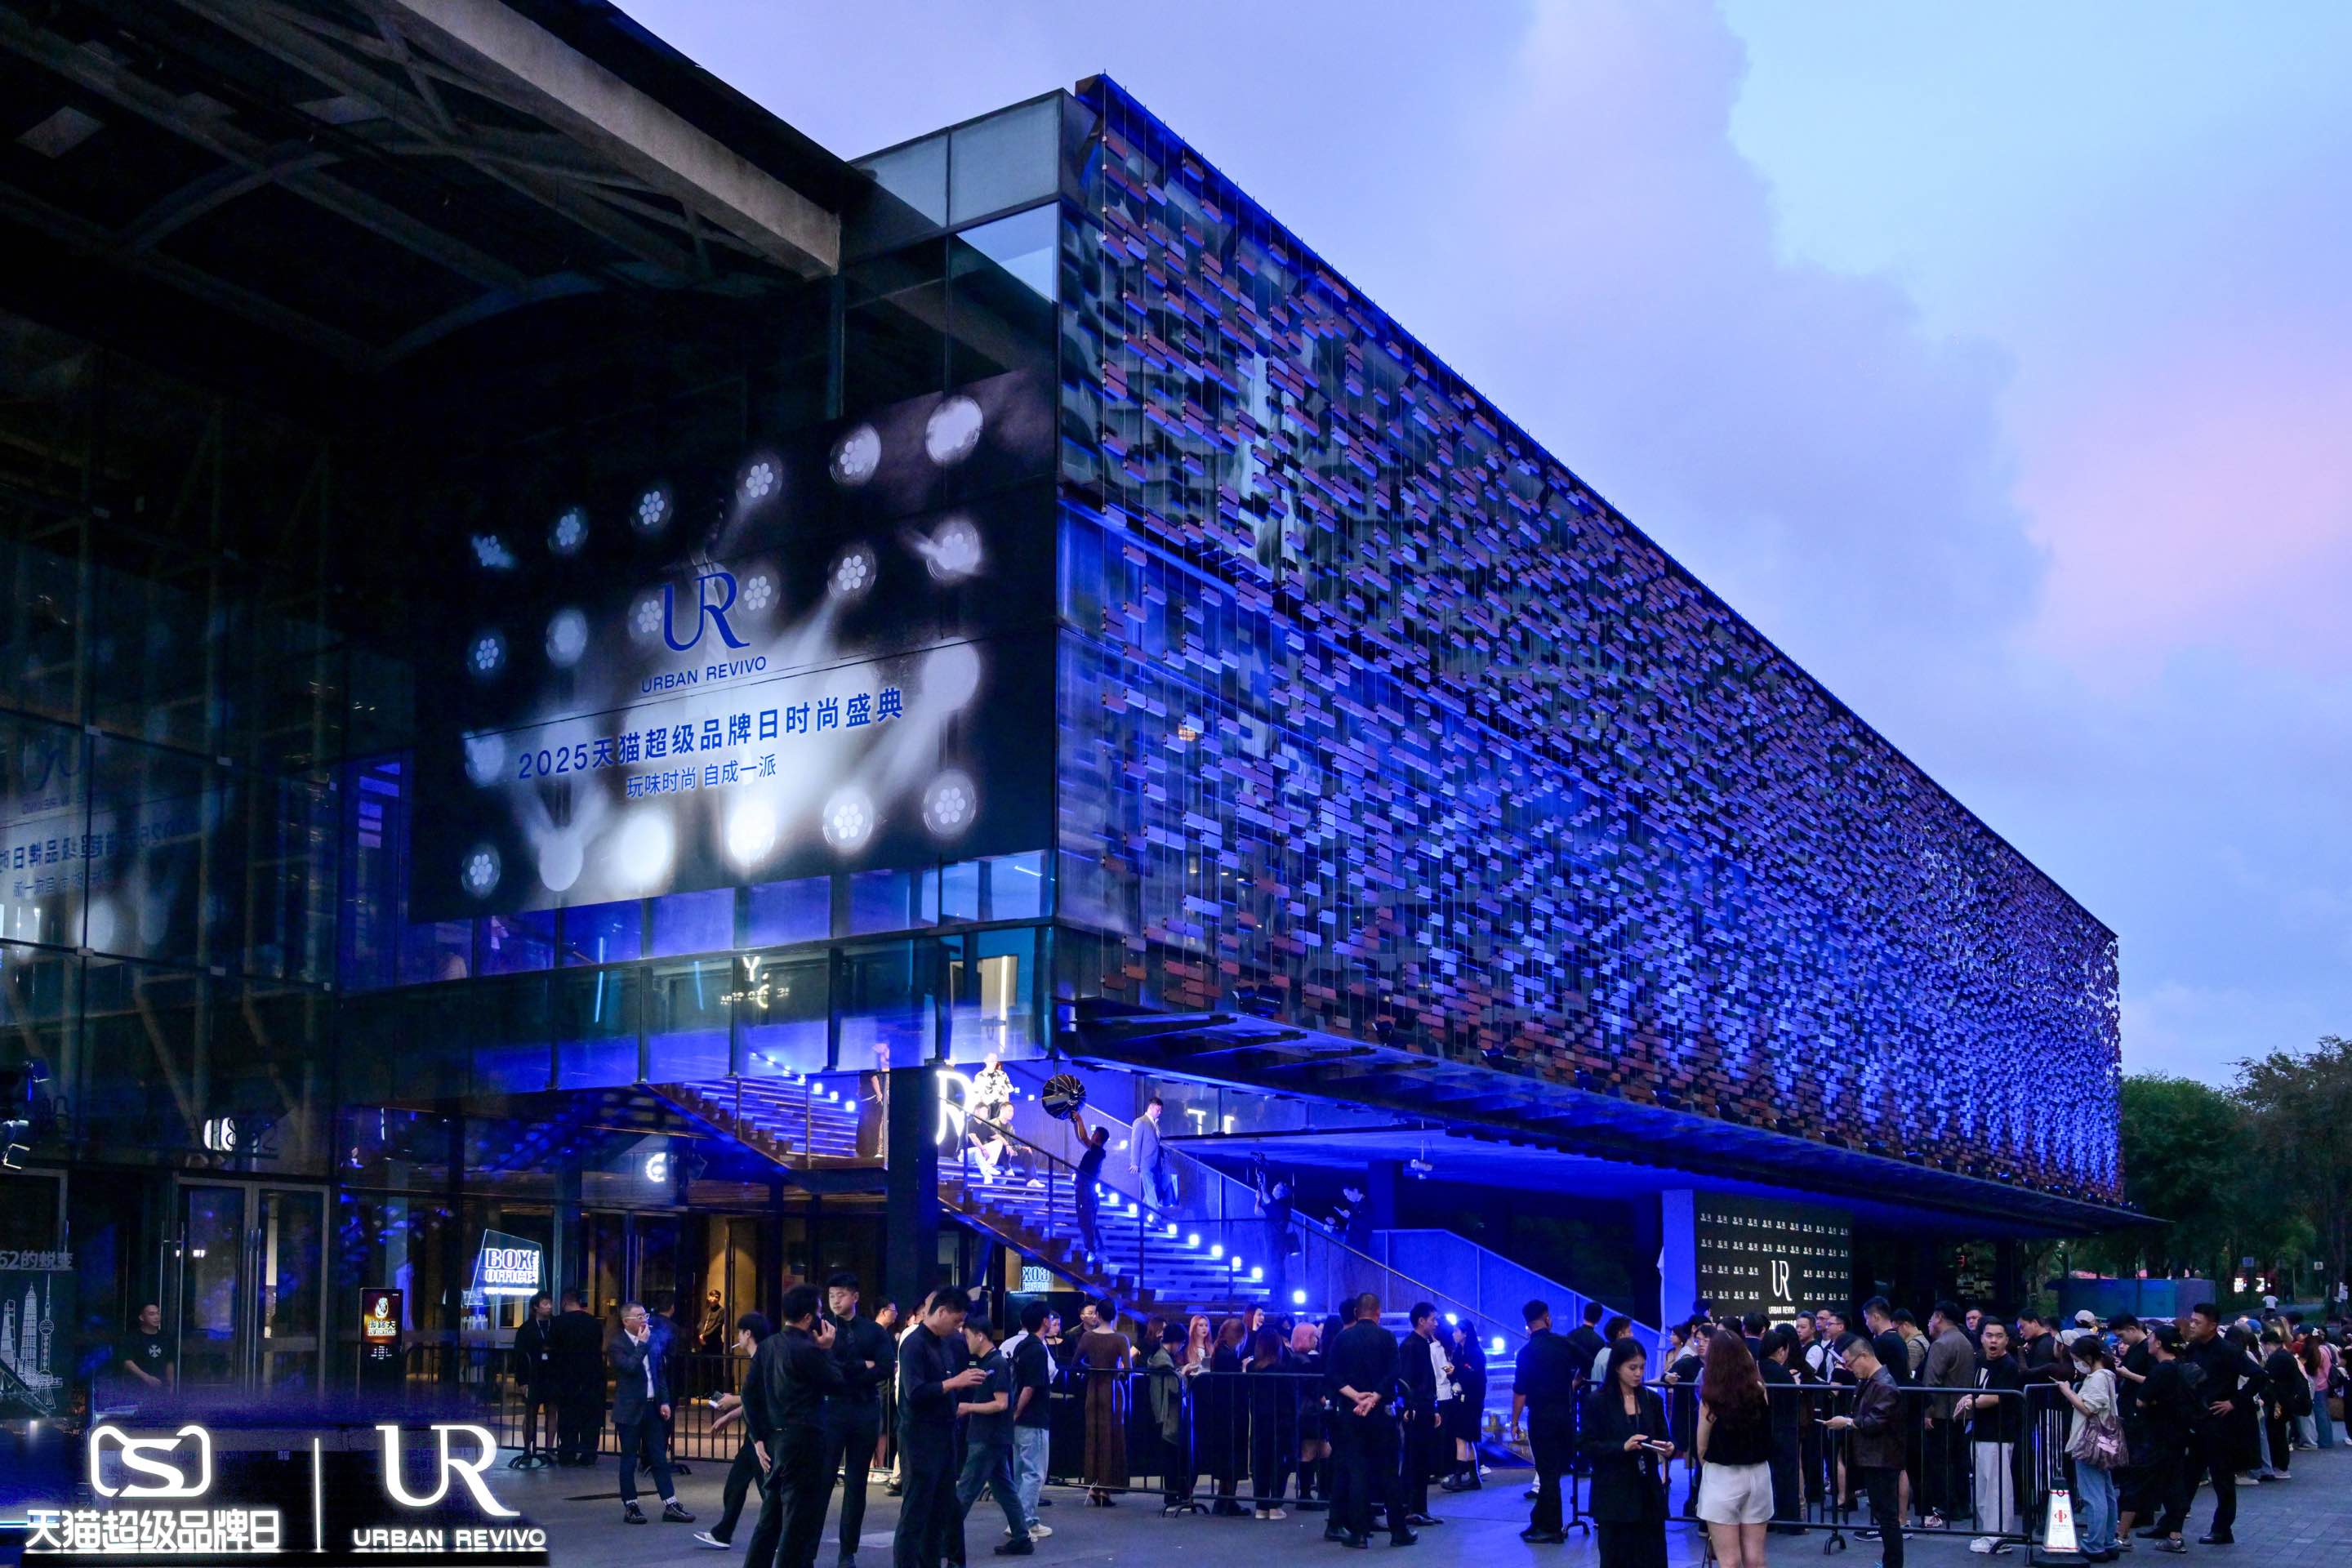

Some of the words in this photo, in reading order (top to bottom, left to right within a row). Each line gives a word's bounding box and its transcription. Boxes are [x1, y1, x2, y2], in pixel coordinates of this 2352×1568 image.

[660, 572, 751, 652] UR
[641, 669, 699, 693] URBAN
[706, 656, 767, 681] REVIVO
[518, 687, 904, 780] 2025天猫超级品牌日时尚盛典
[626, 766, 697, 799] 玩味时尚
[704, 753, 777, 788] 自成一派
[485, 1248, 532, 1269] BOX
[485, 1269, 532, 1283] OFFICE
[1771, 1260, 1793, 1301] UR
[375, 1424, 521, 1517] UR
[24, 1508, 281, 1550] 天猫超级品牌日
[354, 1529, 443, 1548] URBAN
[455, 1528, 546, 1548] REVIVO
